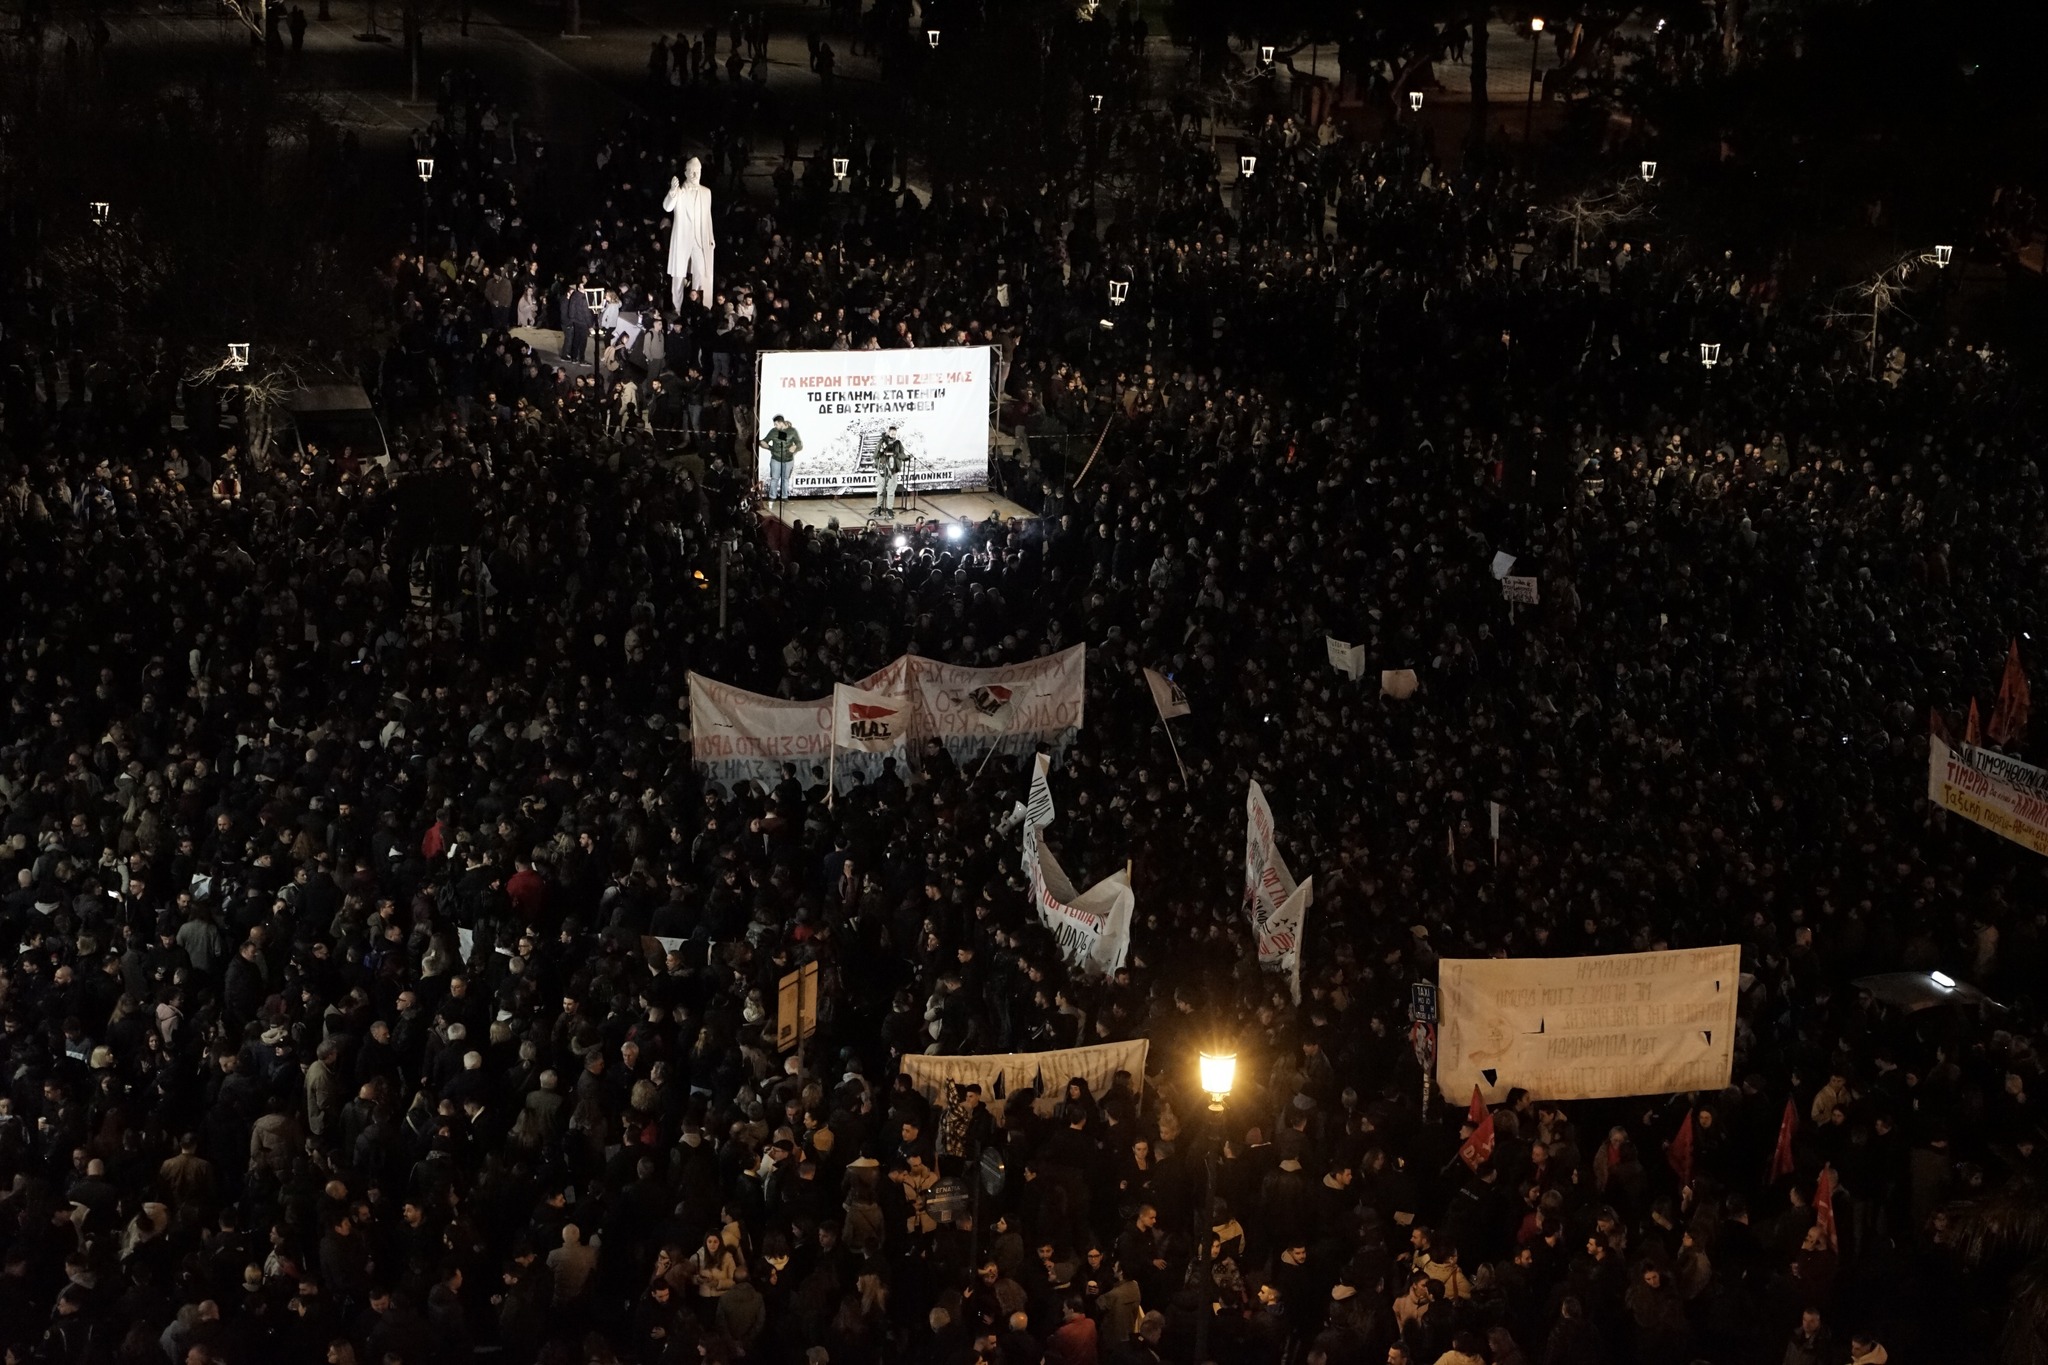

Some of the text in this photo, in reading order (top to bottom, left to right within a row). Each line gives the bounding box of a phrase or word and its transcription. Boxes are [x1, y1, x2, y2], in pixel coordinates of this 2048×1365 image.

[781, 377, 796, 388] ΤΑ
[800, 376, 842, 387] ΚΕΡΔΗ
[807, 392, 822, 402] ΤΟ
[825, 391, 880, 402] ΕΓΚΛΗΜΑ
[883, 389, 904, 400] ΣΤΑ
[819, 404, 833, 414] ΔΕ
[837, 403, 851, 413] ΘΑ
[795, 474, 838, 486] ΕΡΓΑΤΙΚΑ
[1976, 752, 2038, 787] ΤΙΜΩΡΗΘΟΥΝ
[1947, 761, 1989, 798] ΤΙΜΩΡΙΑ
